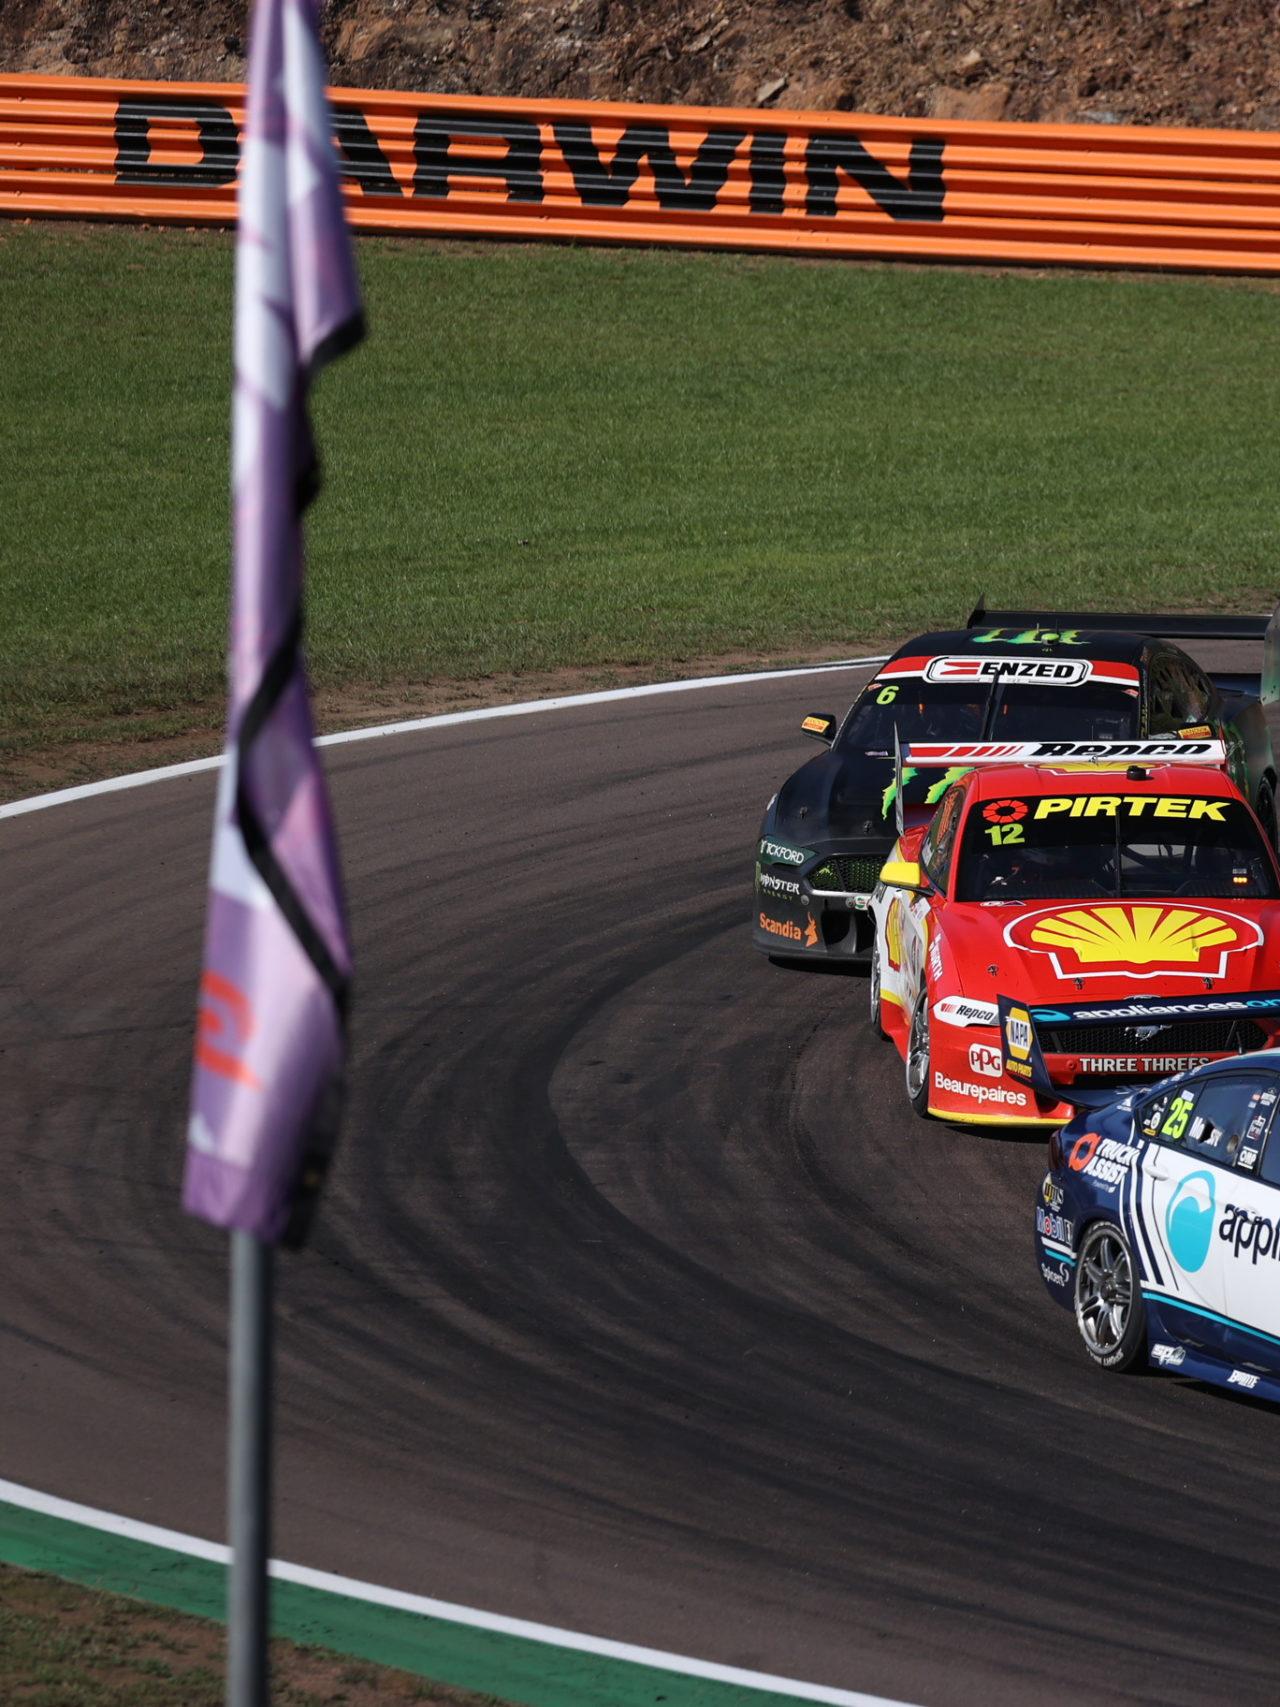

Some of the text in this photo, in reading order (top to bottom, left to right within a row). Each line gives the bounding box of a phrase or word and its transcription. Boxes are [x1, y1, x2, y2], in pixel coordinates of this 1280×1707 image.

[980, 662, 1075, 679] ENZED
[876, 686, 899, 705] 6
[1033, 796, 1232, 822] PIRTEK
[984, 823, 1026, 846] 12
[759, 912, 802, 940] Scandia
[956, 1004, 994, 1022] Repco
[1009, 1019, 1029, 1048] NAPA
[971, 1048, 1001, 1072] PPG
[1080, 1058, 1137, 1073] THREE
[935, 1072, 1027, 1106] Beaurepaires
[1161, 1097, 1194, 1139] 25
[1096, 1138, 1141, 1166] TRUCK
[1083, 1156, 1130, 1185] ASSIST
[1036, 1206, 1064, 1242] Mobil
